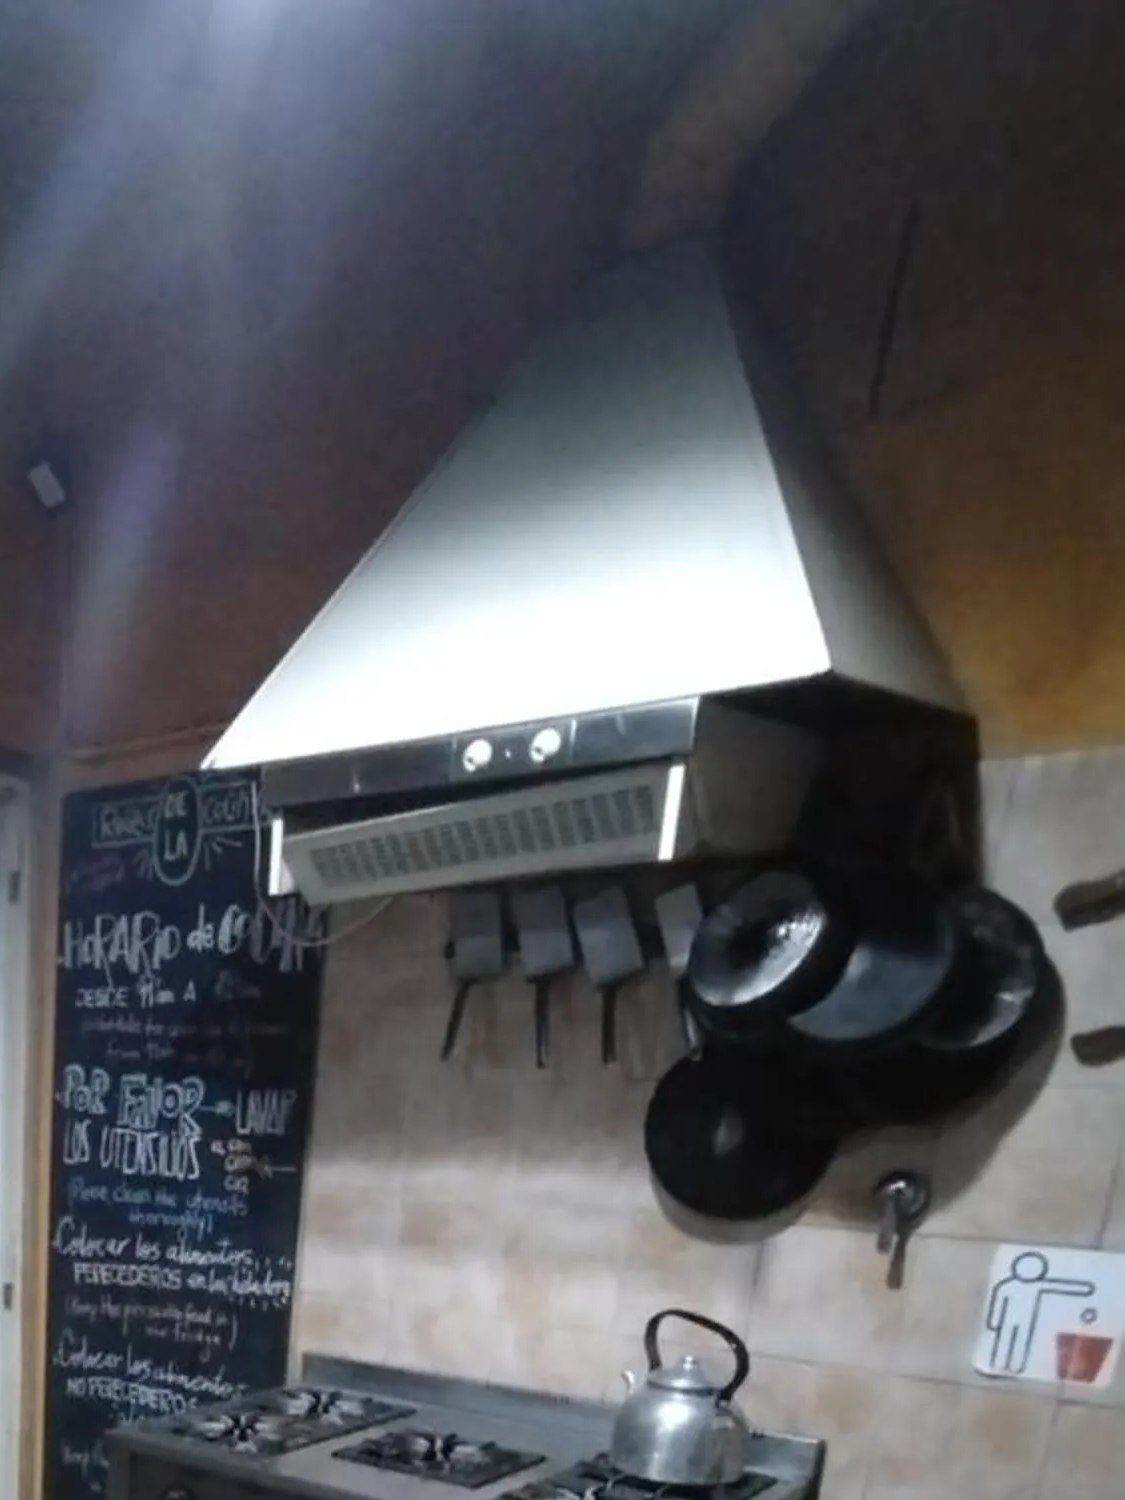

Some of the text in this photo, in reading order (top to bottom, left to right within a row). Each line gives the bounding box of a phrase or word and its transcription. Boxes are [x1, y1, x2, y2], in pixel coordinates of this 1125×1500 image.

[163, 829, 189, 862] LA
[63, 1062, 112, 1116] POR
[63, 1117, 92, 1166] LOS
